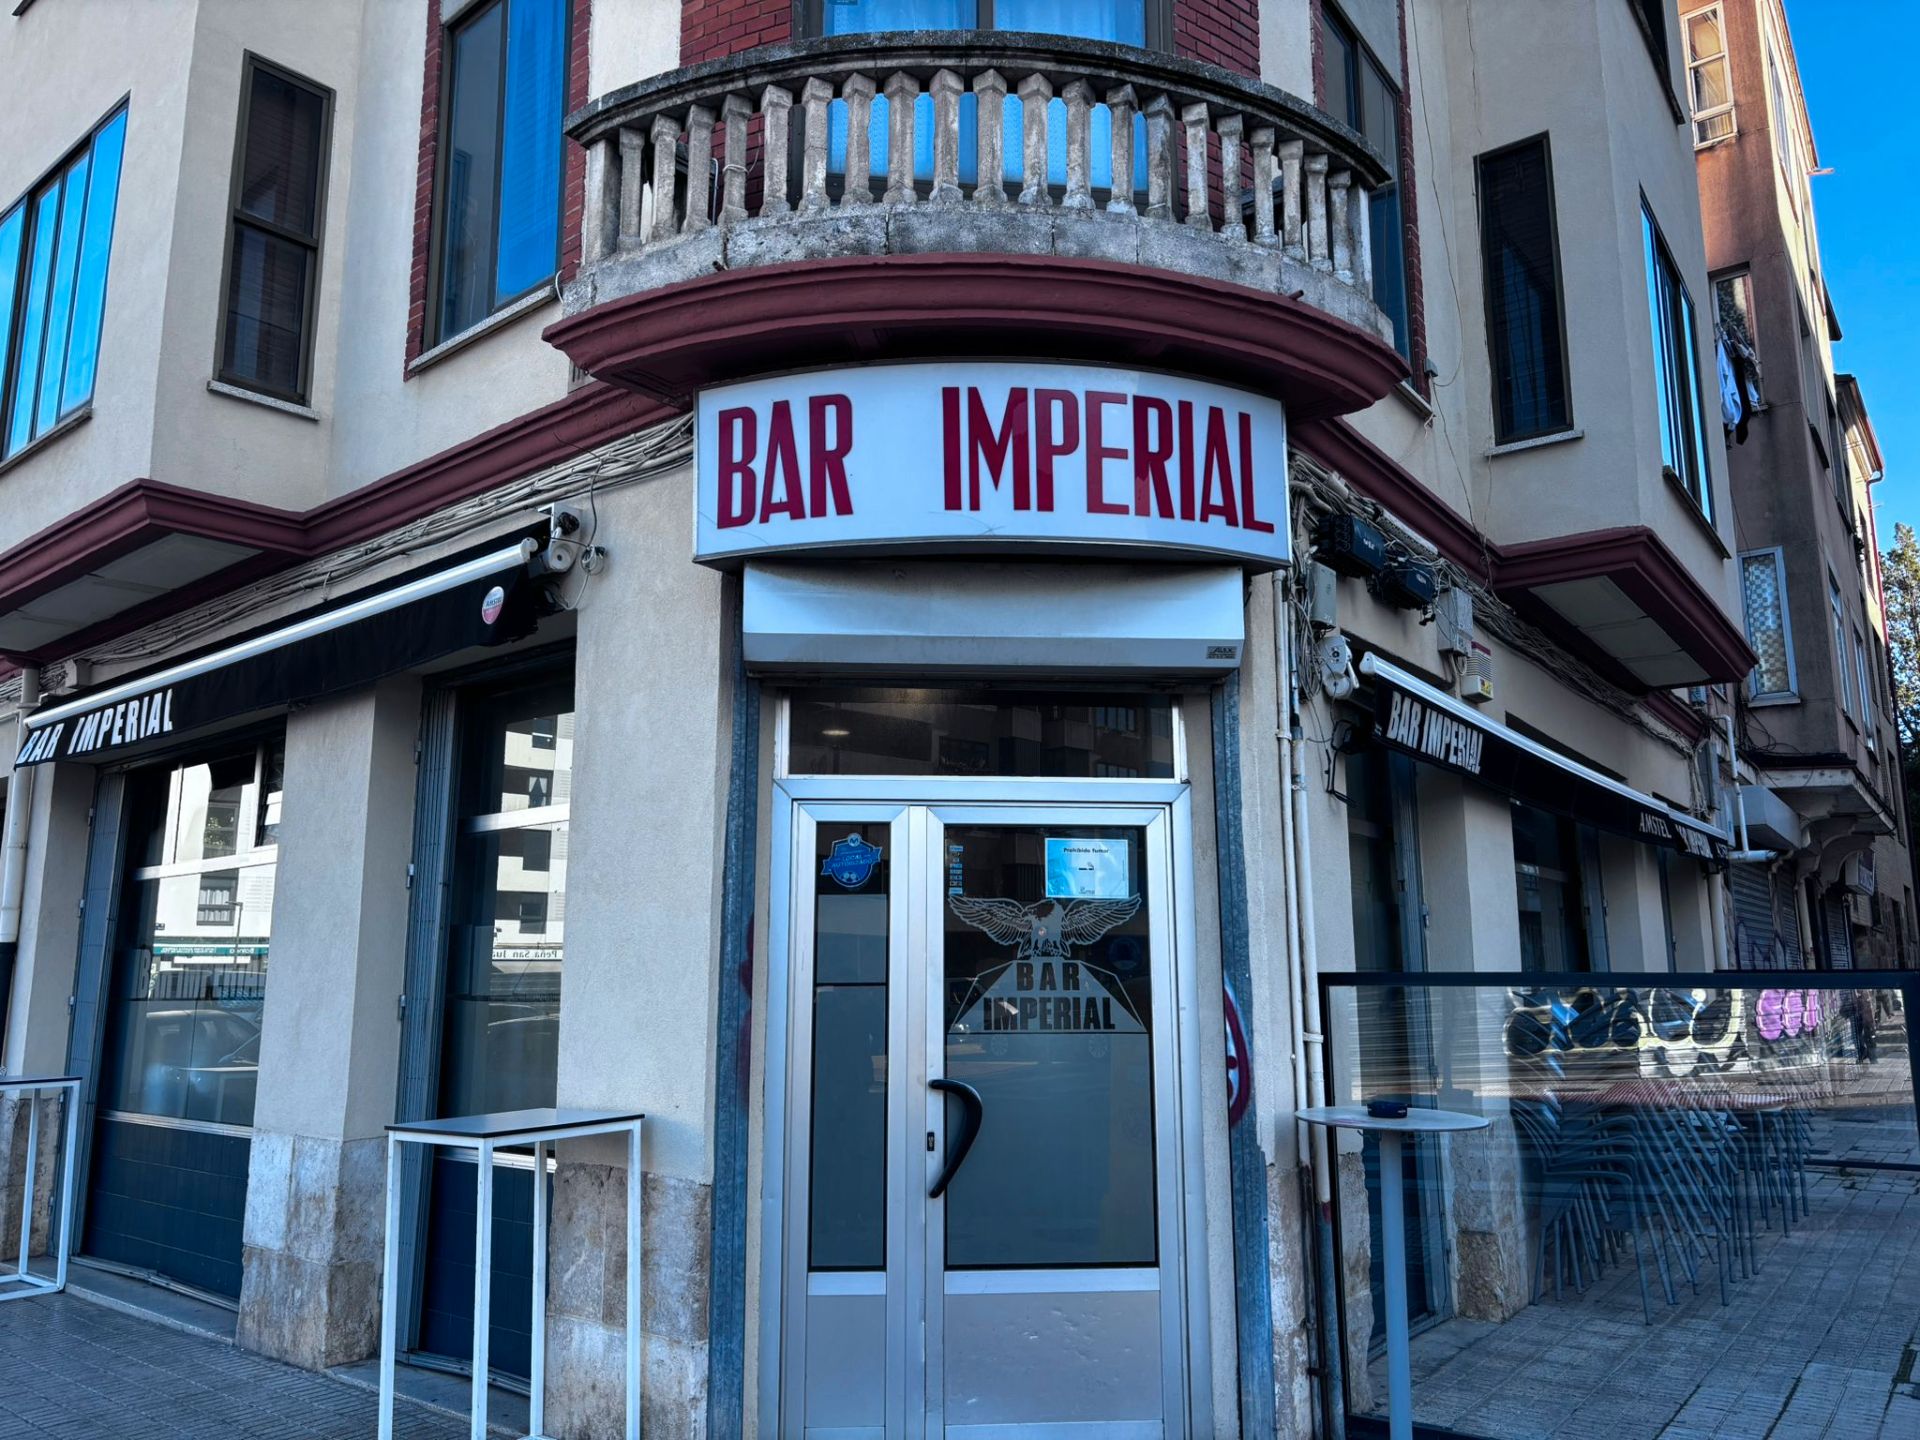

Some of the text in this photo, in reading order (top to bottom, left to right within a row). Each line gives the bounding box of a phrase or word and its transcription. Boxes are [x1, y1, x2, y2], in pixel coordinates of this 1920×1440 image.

[717, 386, 1274, 533] BAR IMPERIAL
[16, 688, 173, 764] BAR IMPERIAL
[1386, 690, 1483, 775] BAR IMPERIAL
[1639, 812, 1672, 838] AMSTEL
[1016, 962, 1080, 991] BAR
[983, 997, 1116, 1031] IMPERIAL
